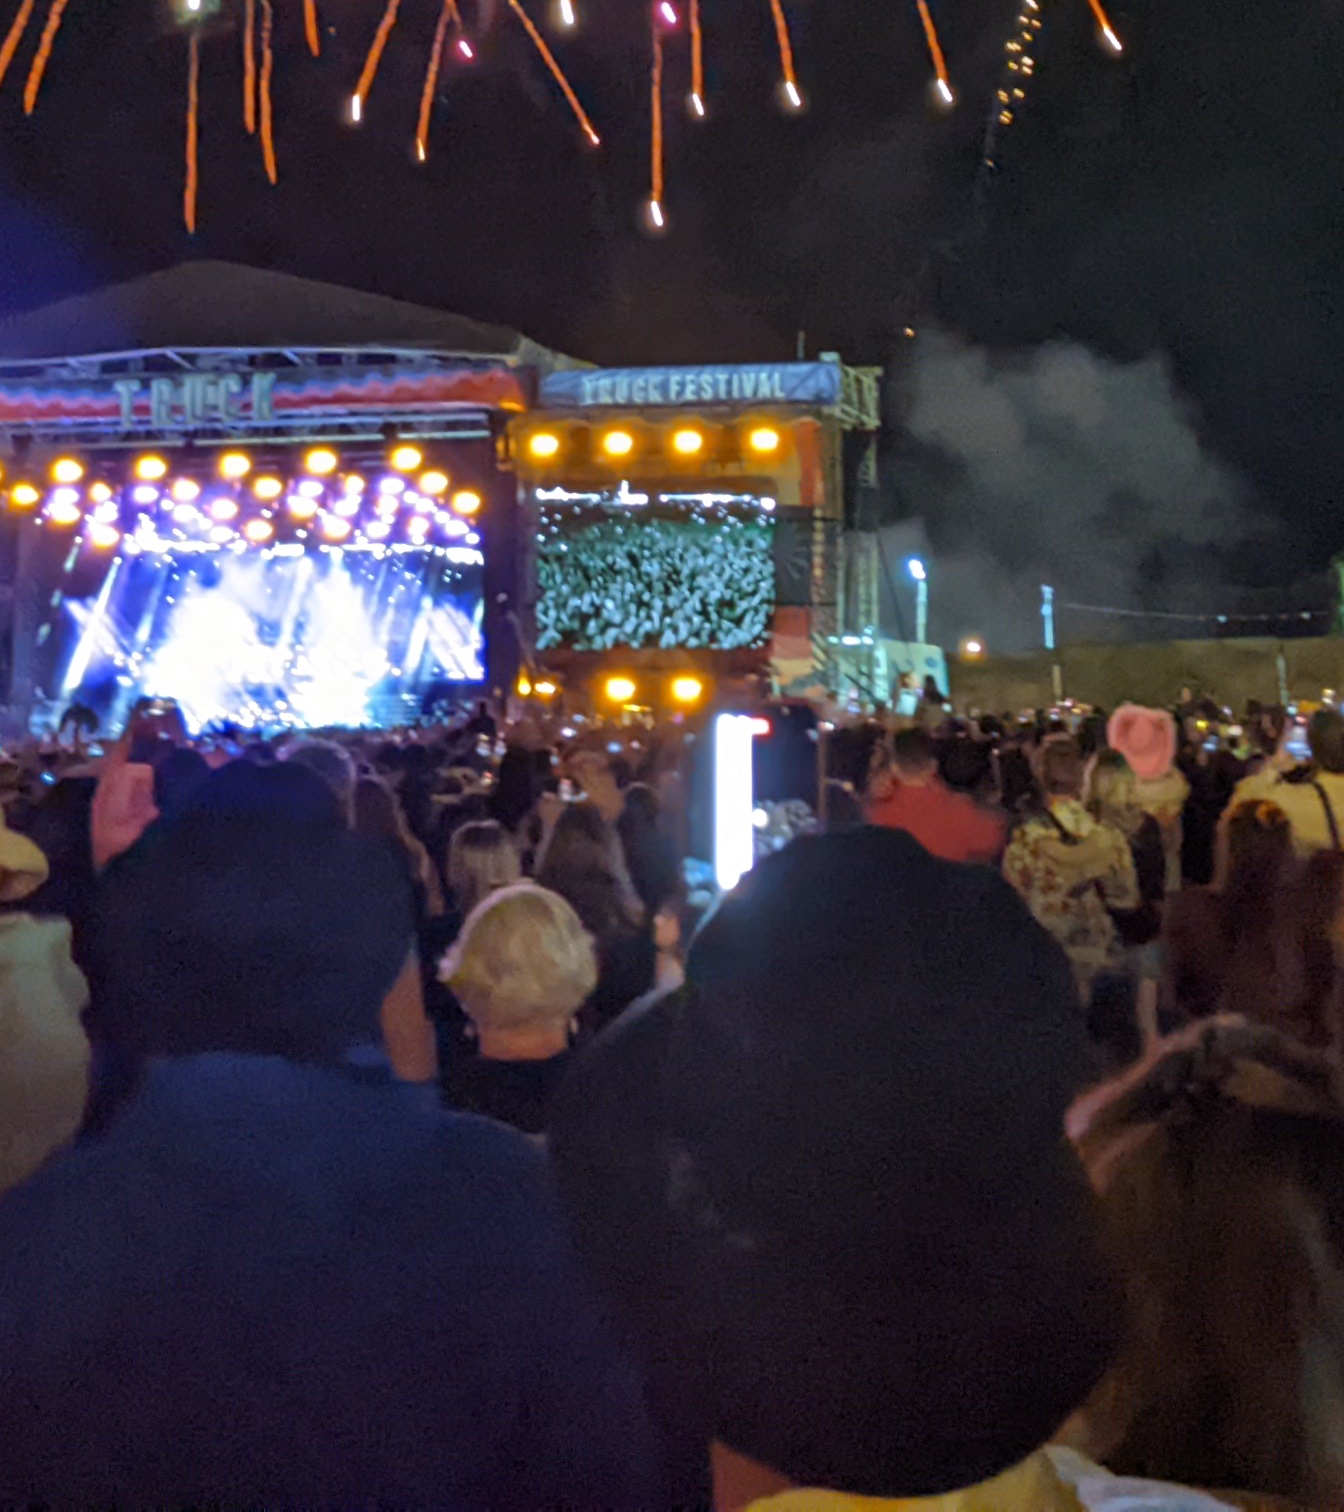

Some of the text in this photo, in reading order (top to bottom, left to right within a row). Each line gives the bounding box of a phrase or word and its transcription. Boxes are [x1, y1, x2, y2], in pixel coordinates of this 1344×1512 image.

[112, 372, 277, 429] TRUCK
[581, 371, 786, 405] TRUCK FESTIVAL
